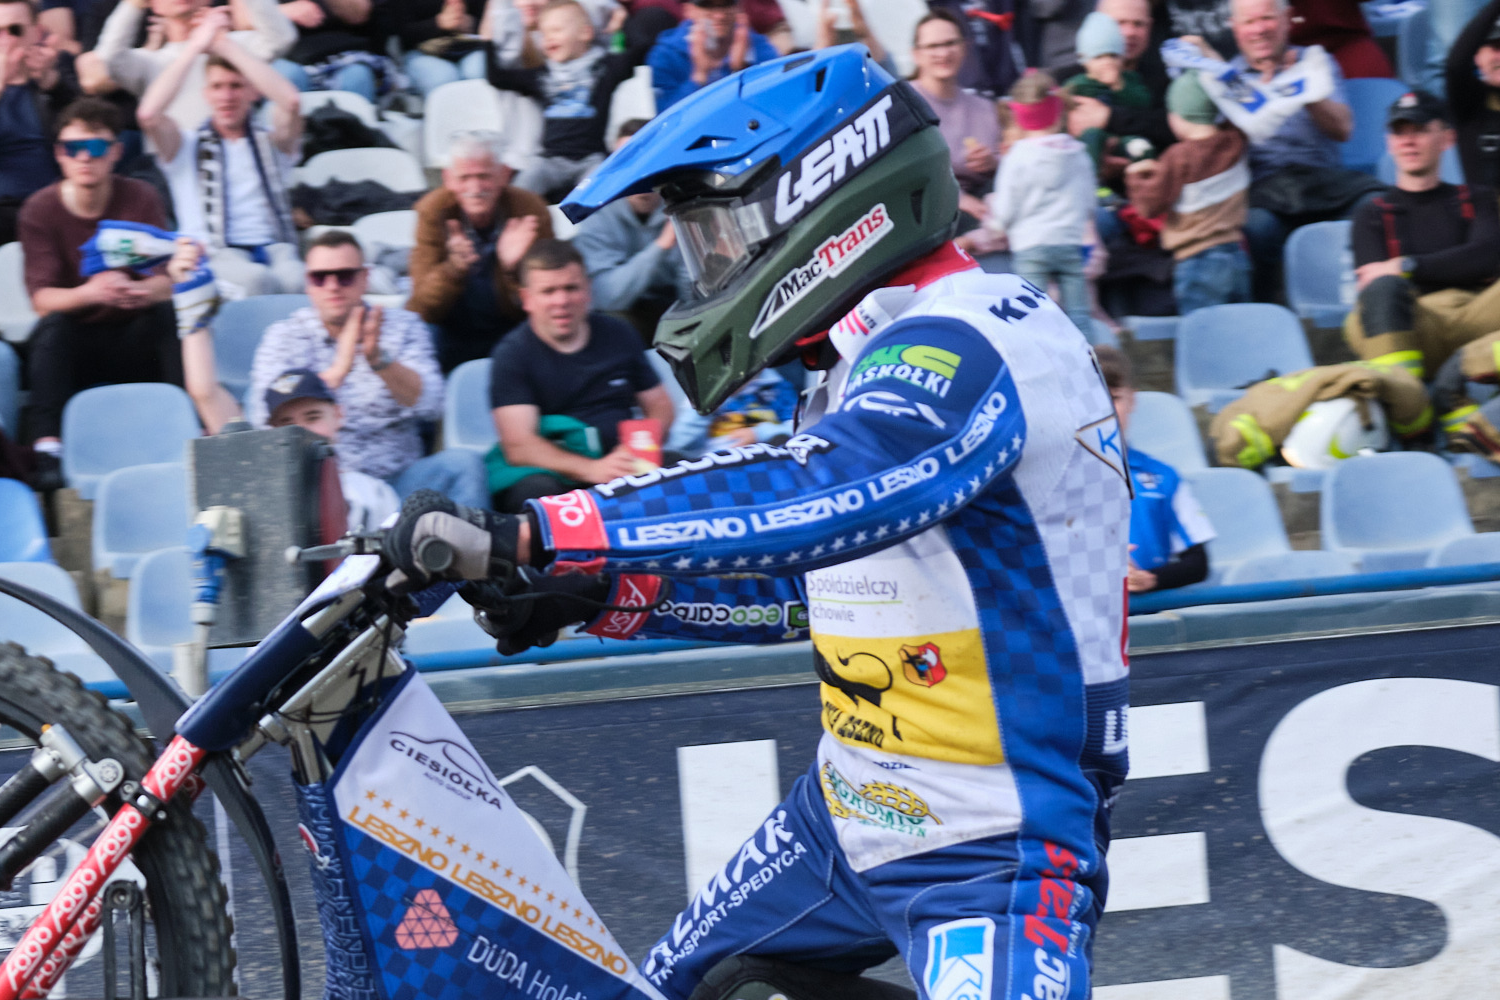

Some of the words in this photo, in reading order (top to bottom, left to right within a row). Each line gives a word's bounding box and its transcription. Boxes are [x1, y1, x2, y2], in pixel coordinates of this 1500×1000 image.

[781, 260, 823, 301] Mac
[819, 207, 885, 268] Trans
[619, 515, 748, 549] LESZNO
[751, 488, 865, 535] LESZNO
[808, 572, 899, 600] Spółdzielczy
[389, 737, 503, 811] CIESIÓŁKA
[347, 805, 449, 873] LESZNO
[450, 864, 542, 925] LESZNO
[541, 914, 629, 976] LESZNO
